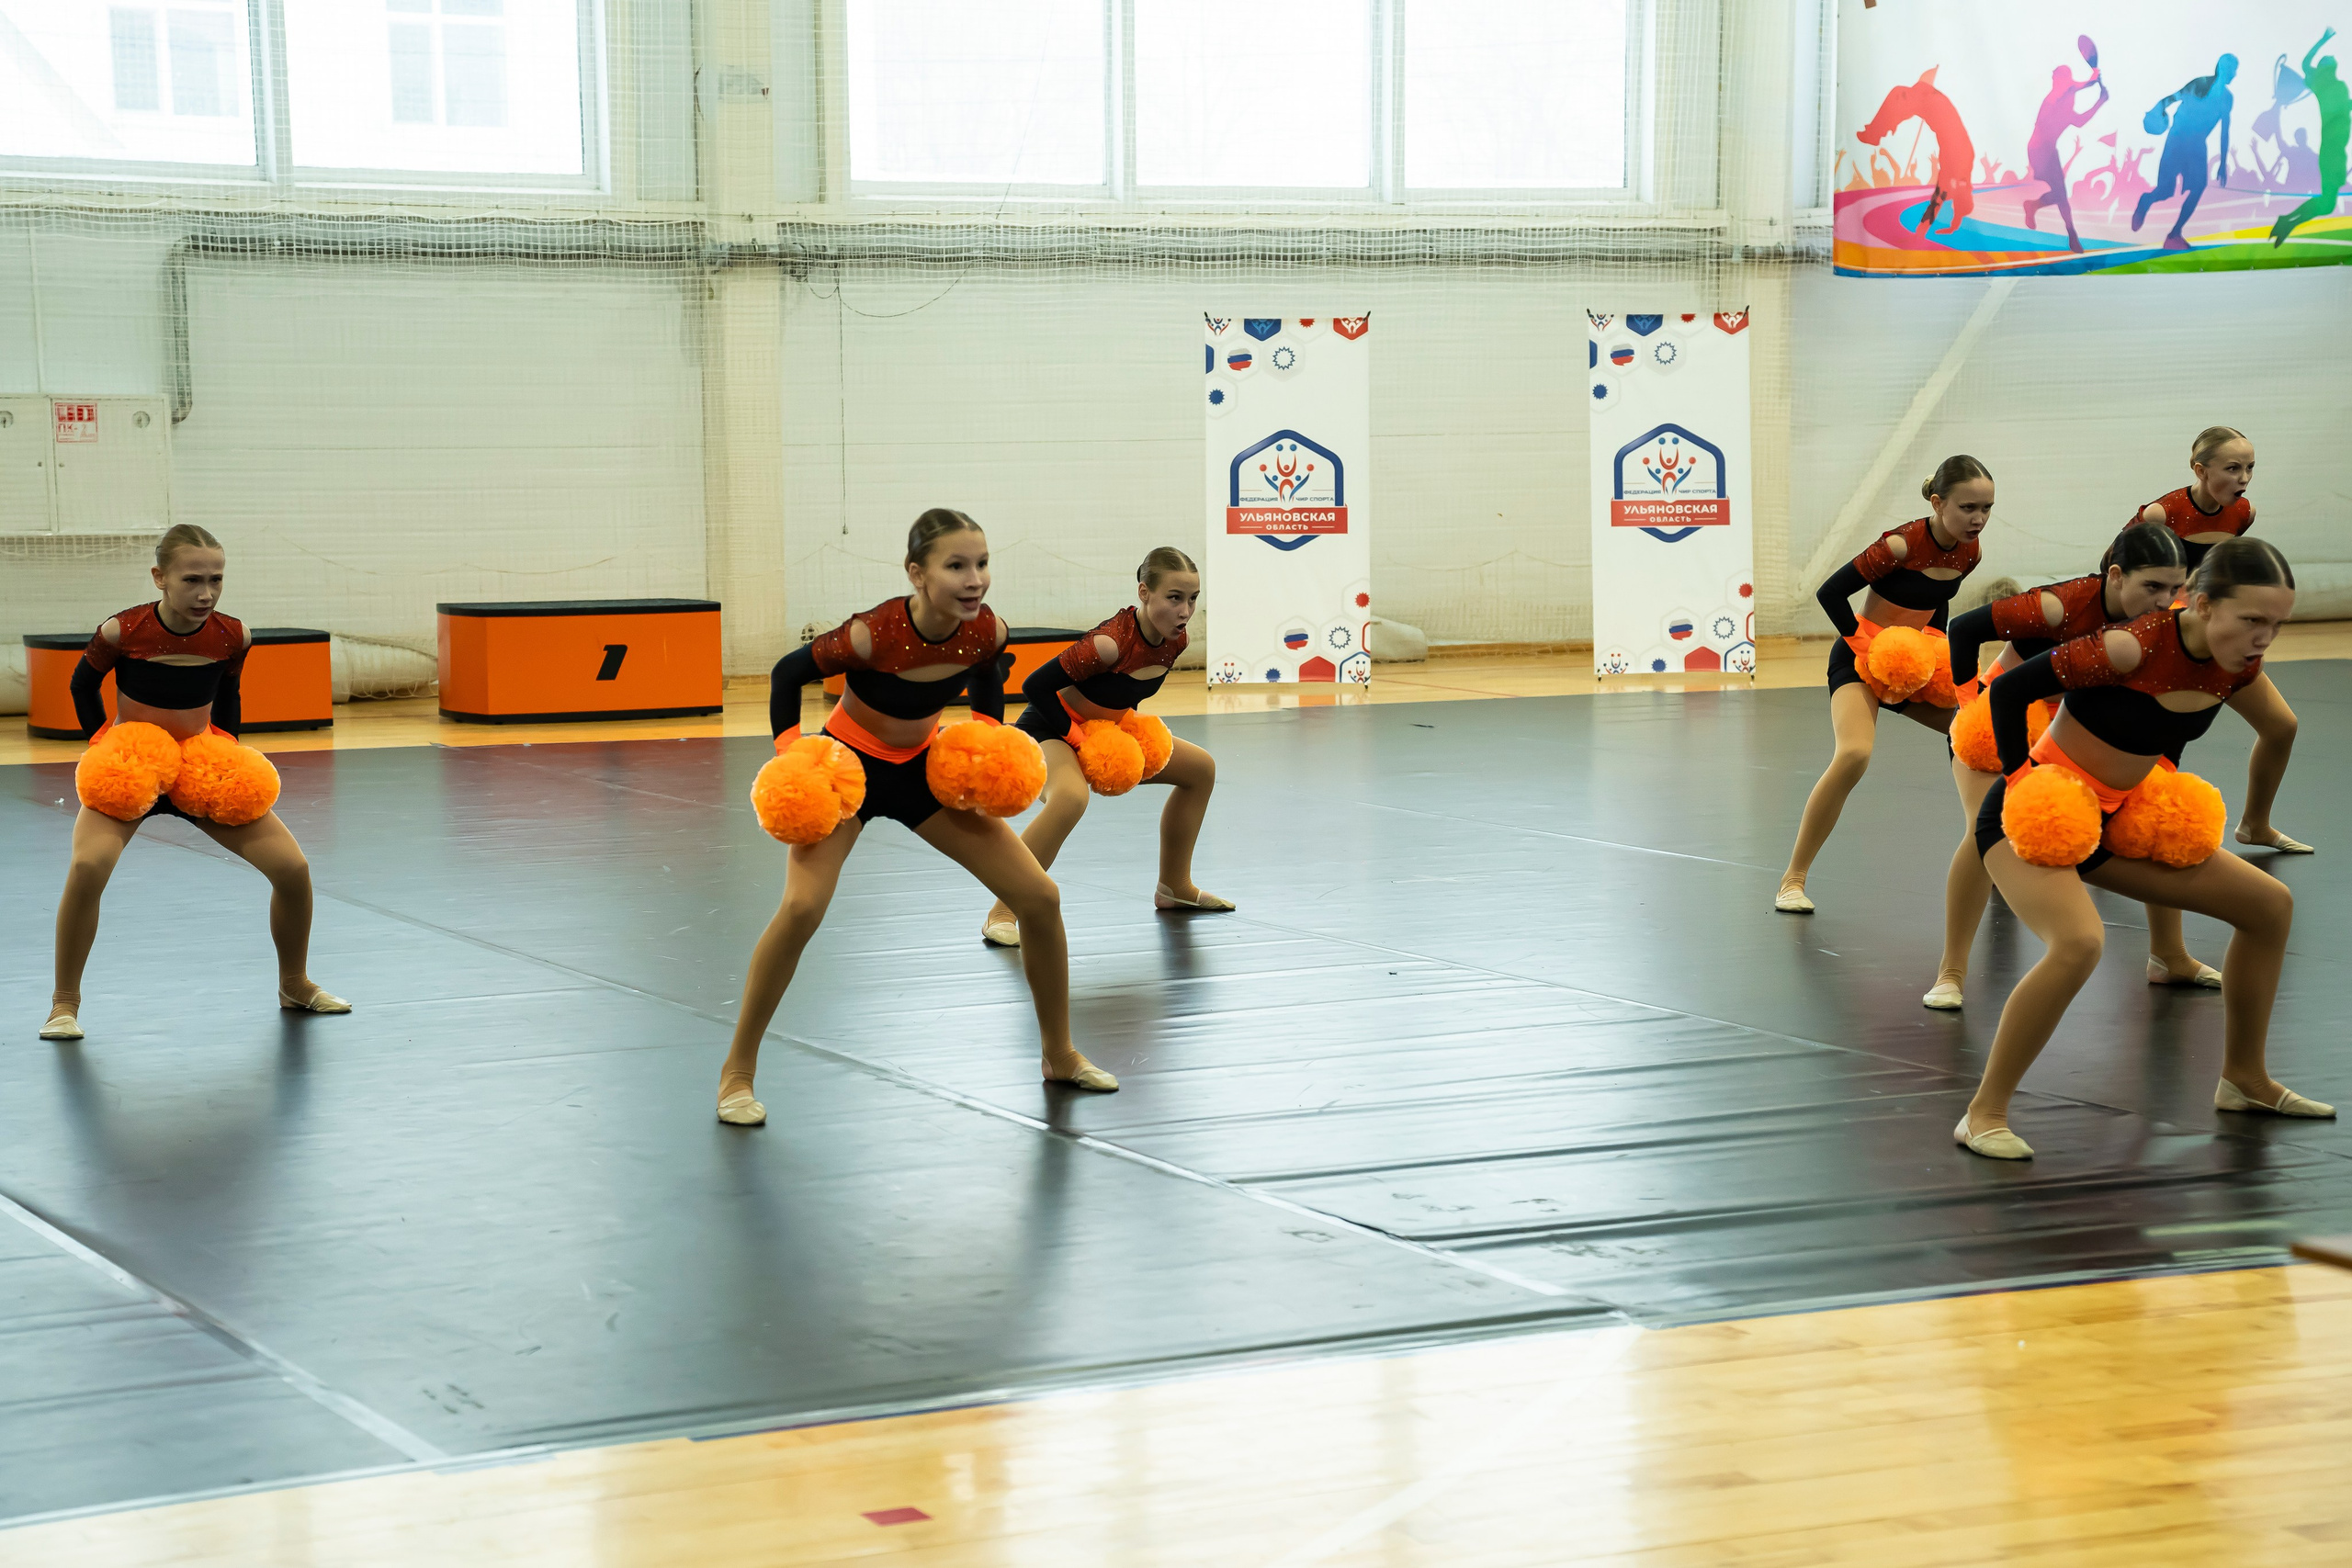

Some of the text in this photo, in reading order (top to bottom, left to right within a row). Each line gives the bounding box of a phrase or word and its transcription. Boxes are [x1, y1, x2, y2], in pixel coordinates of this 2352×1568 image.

[1623, 504, 1718, 514] УЛЬЯНОВСКАЯ
[1239, 513, 1336, 522] УЛЬЯНОВСКАЯ
[595, 644, 628, 681] 1
